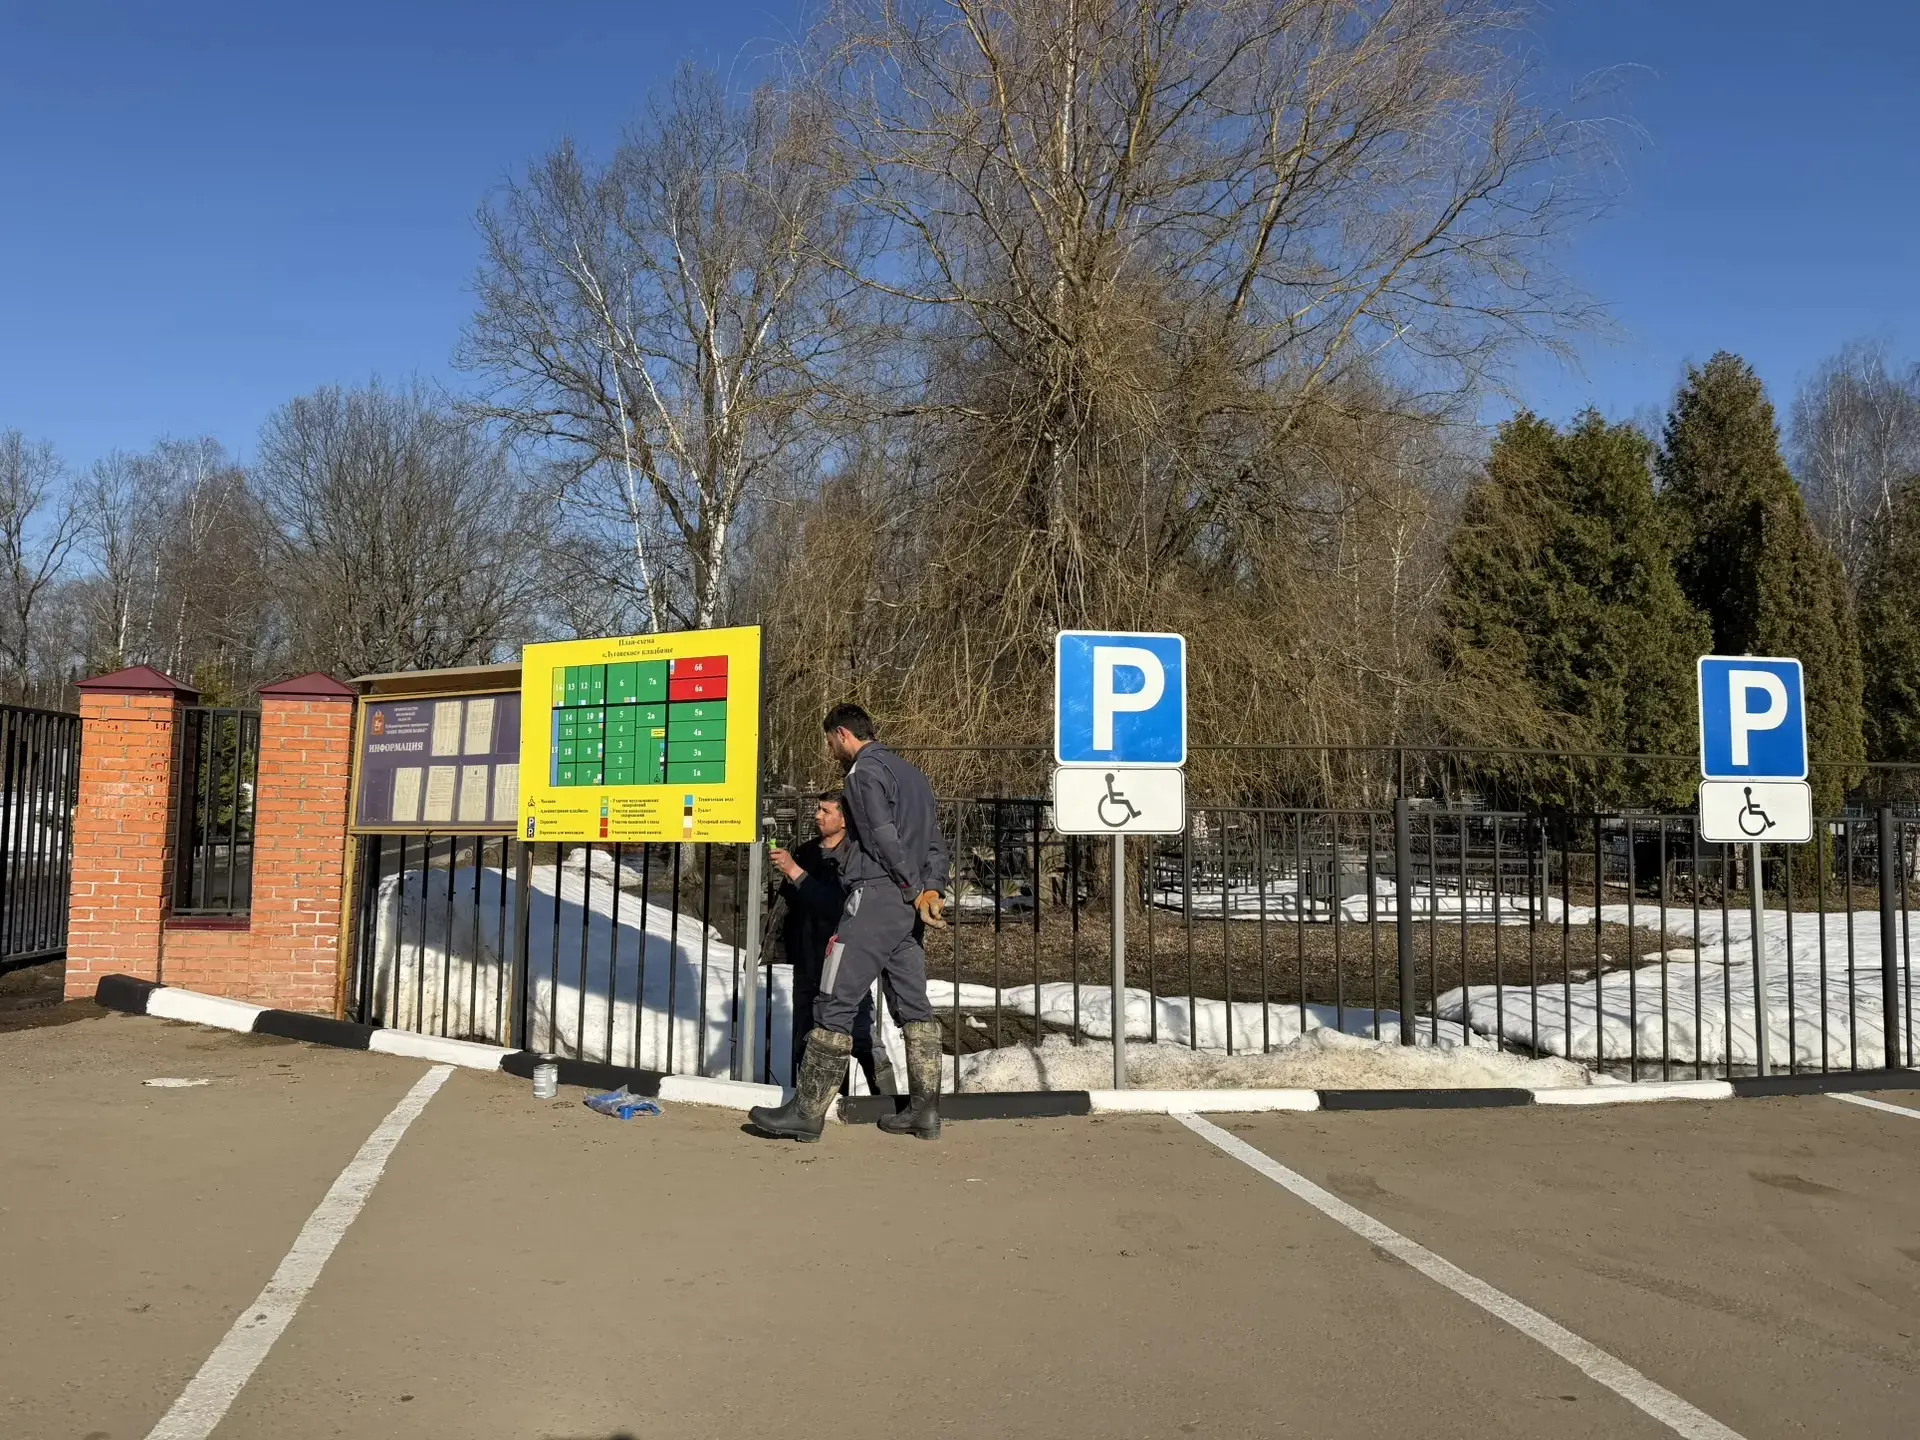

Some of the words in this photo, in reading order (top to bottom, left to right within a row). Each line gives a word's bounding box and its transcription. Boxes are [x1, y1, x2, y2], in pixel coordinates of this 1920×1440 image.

[368, 742, 423, 752] ИНФОРМАЦИЯ
[1092, 645, 1166, 752] P
[1728, 669, 1789, 766] P
